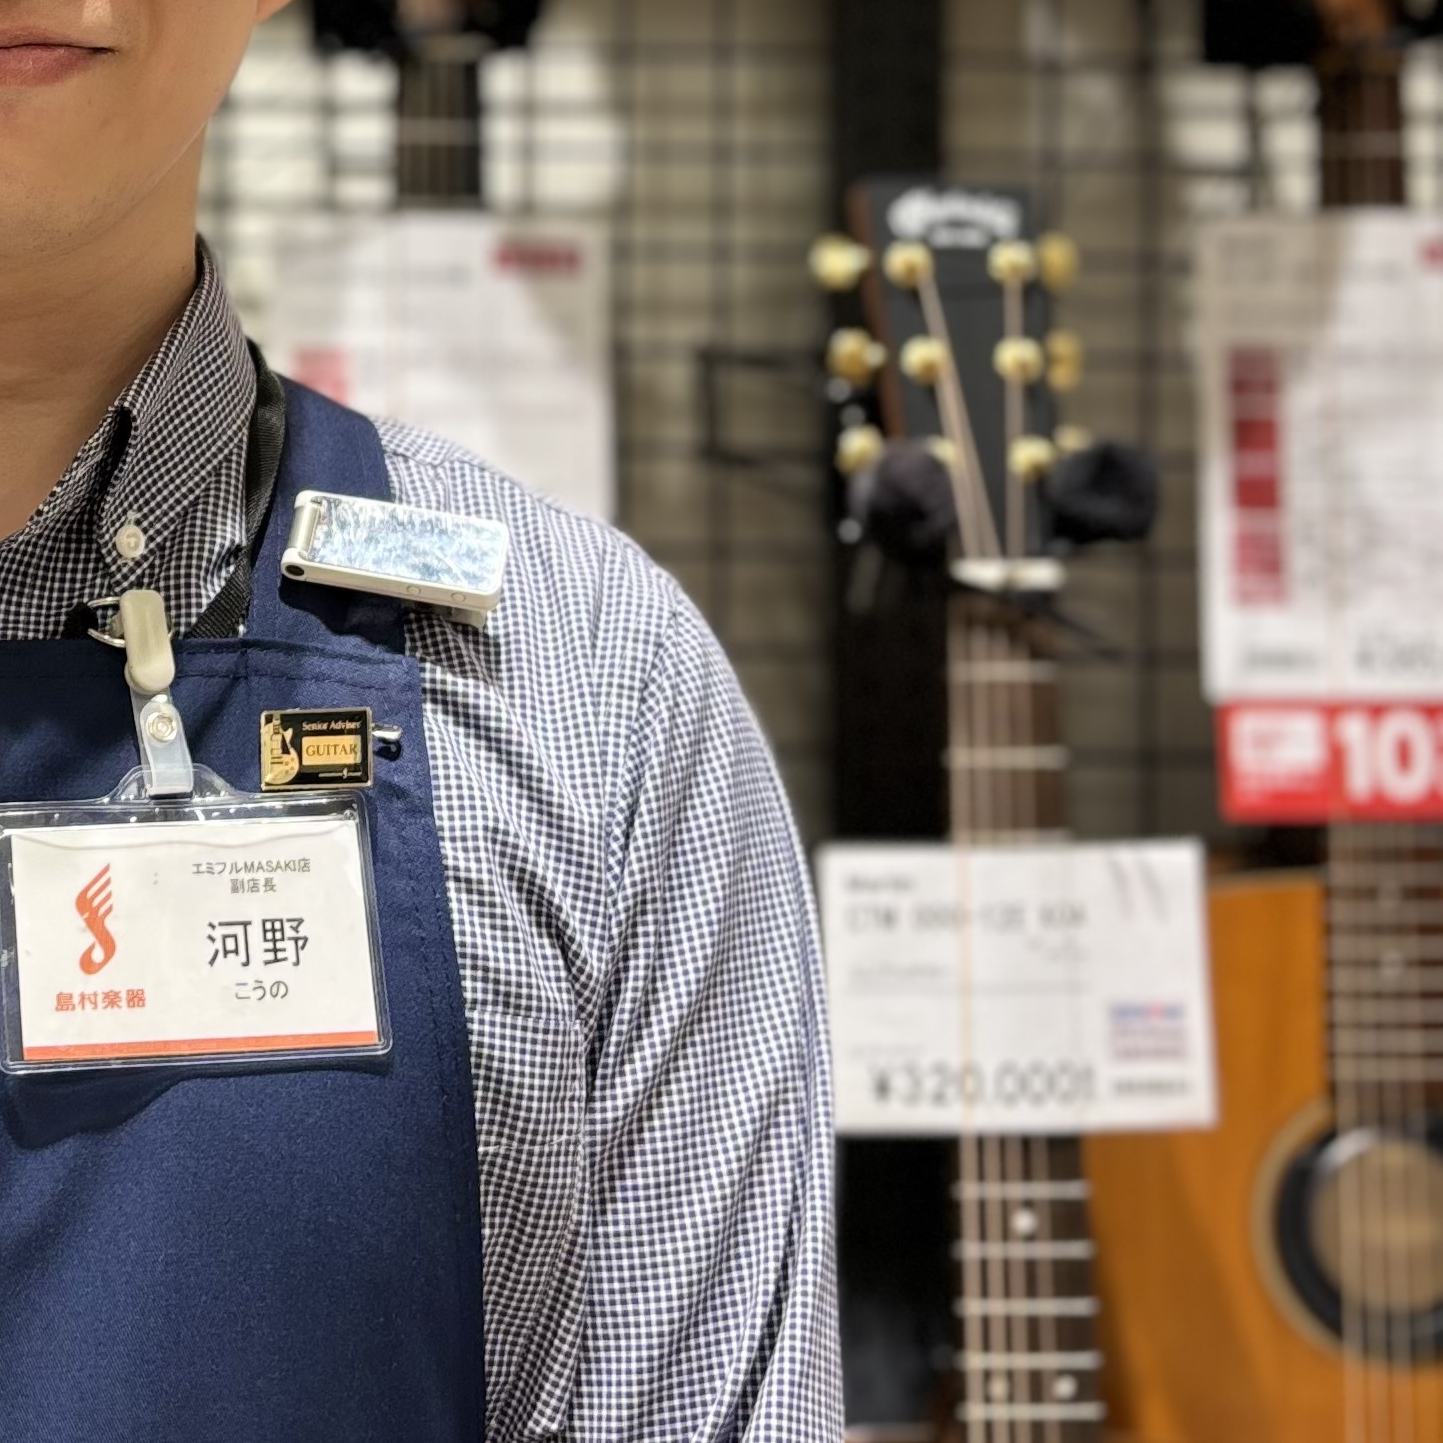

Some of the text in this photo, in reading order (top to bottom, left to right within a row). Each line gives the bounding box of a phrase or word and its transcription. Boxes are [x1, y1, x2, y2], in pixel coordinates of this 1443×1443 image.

[301, 719, 329, 732] Senior
[305, 743, 358, 757] GUITAR
[1334, 710, 1443, 805] 10
[191, 858, 311, 875] エミフルMASAKI店
[230, 877, 277, 894] 副店長
[207, 917, 309, 967] 河野
[235, 979, 289, 1001] こうの
[55, 989, 146, 1012] 島村楽器
